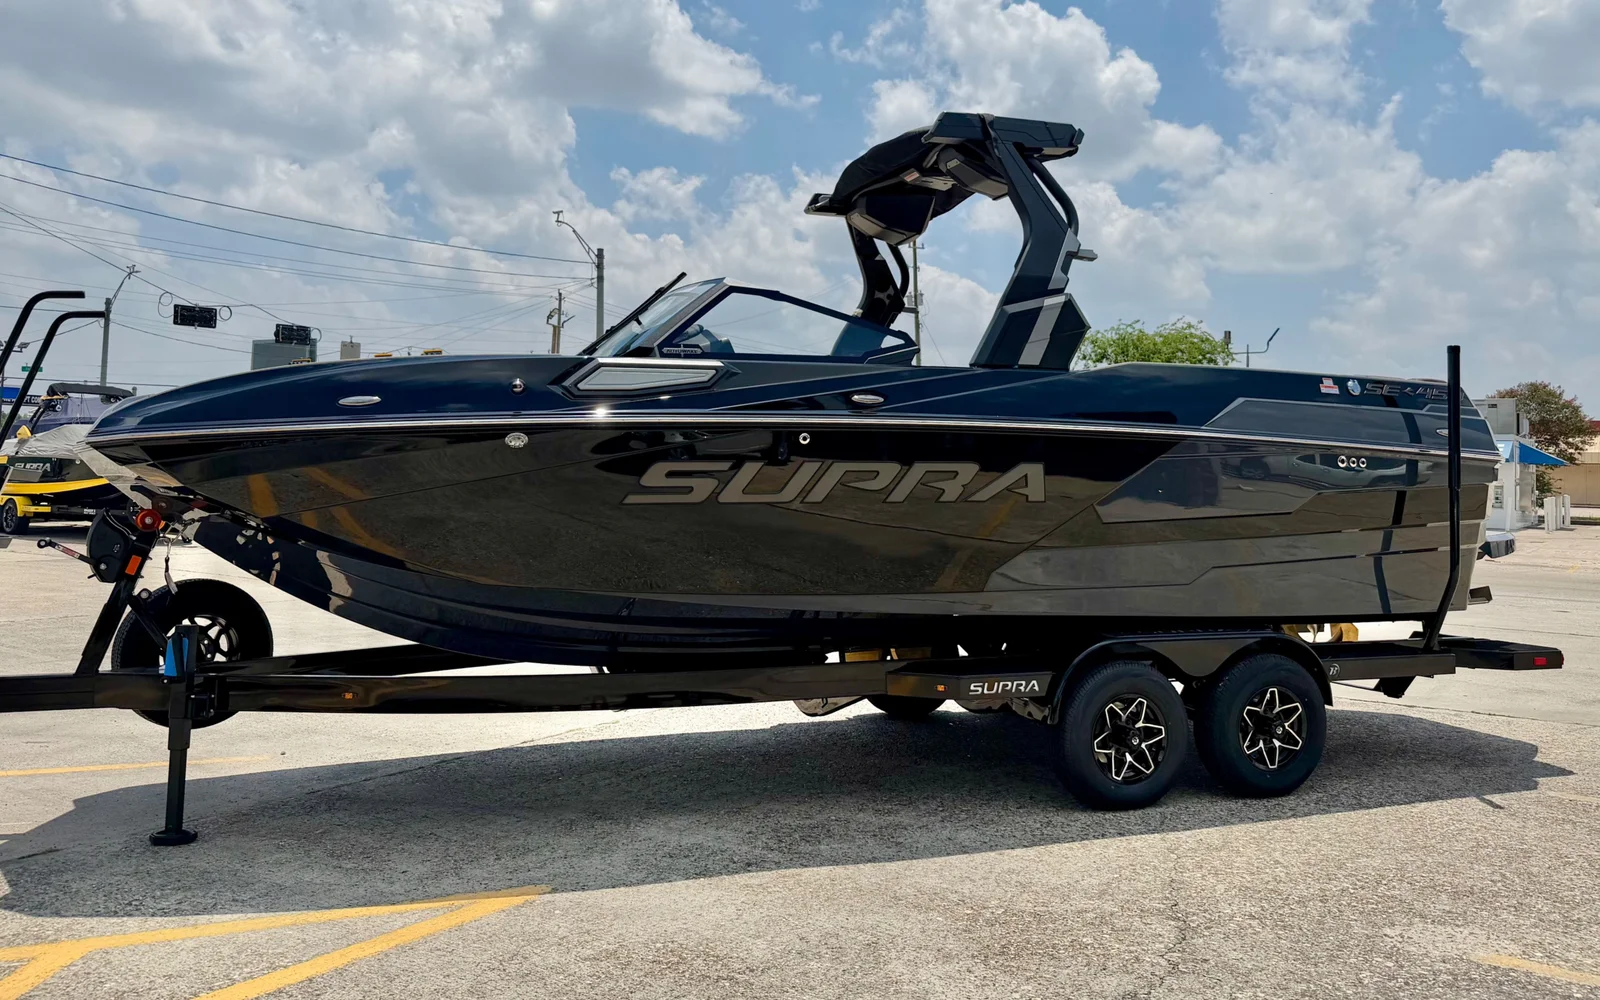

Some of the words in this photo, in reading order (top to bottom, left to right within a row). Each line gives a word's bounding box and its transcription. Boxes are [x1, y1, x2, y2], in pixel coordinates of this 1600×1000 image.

[1364, 382, 1401, 397] SE
[621, 461, 1047, 504] SUPRA
[969, 680, 1040, 695] SUPRA
